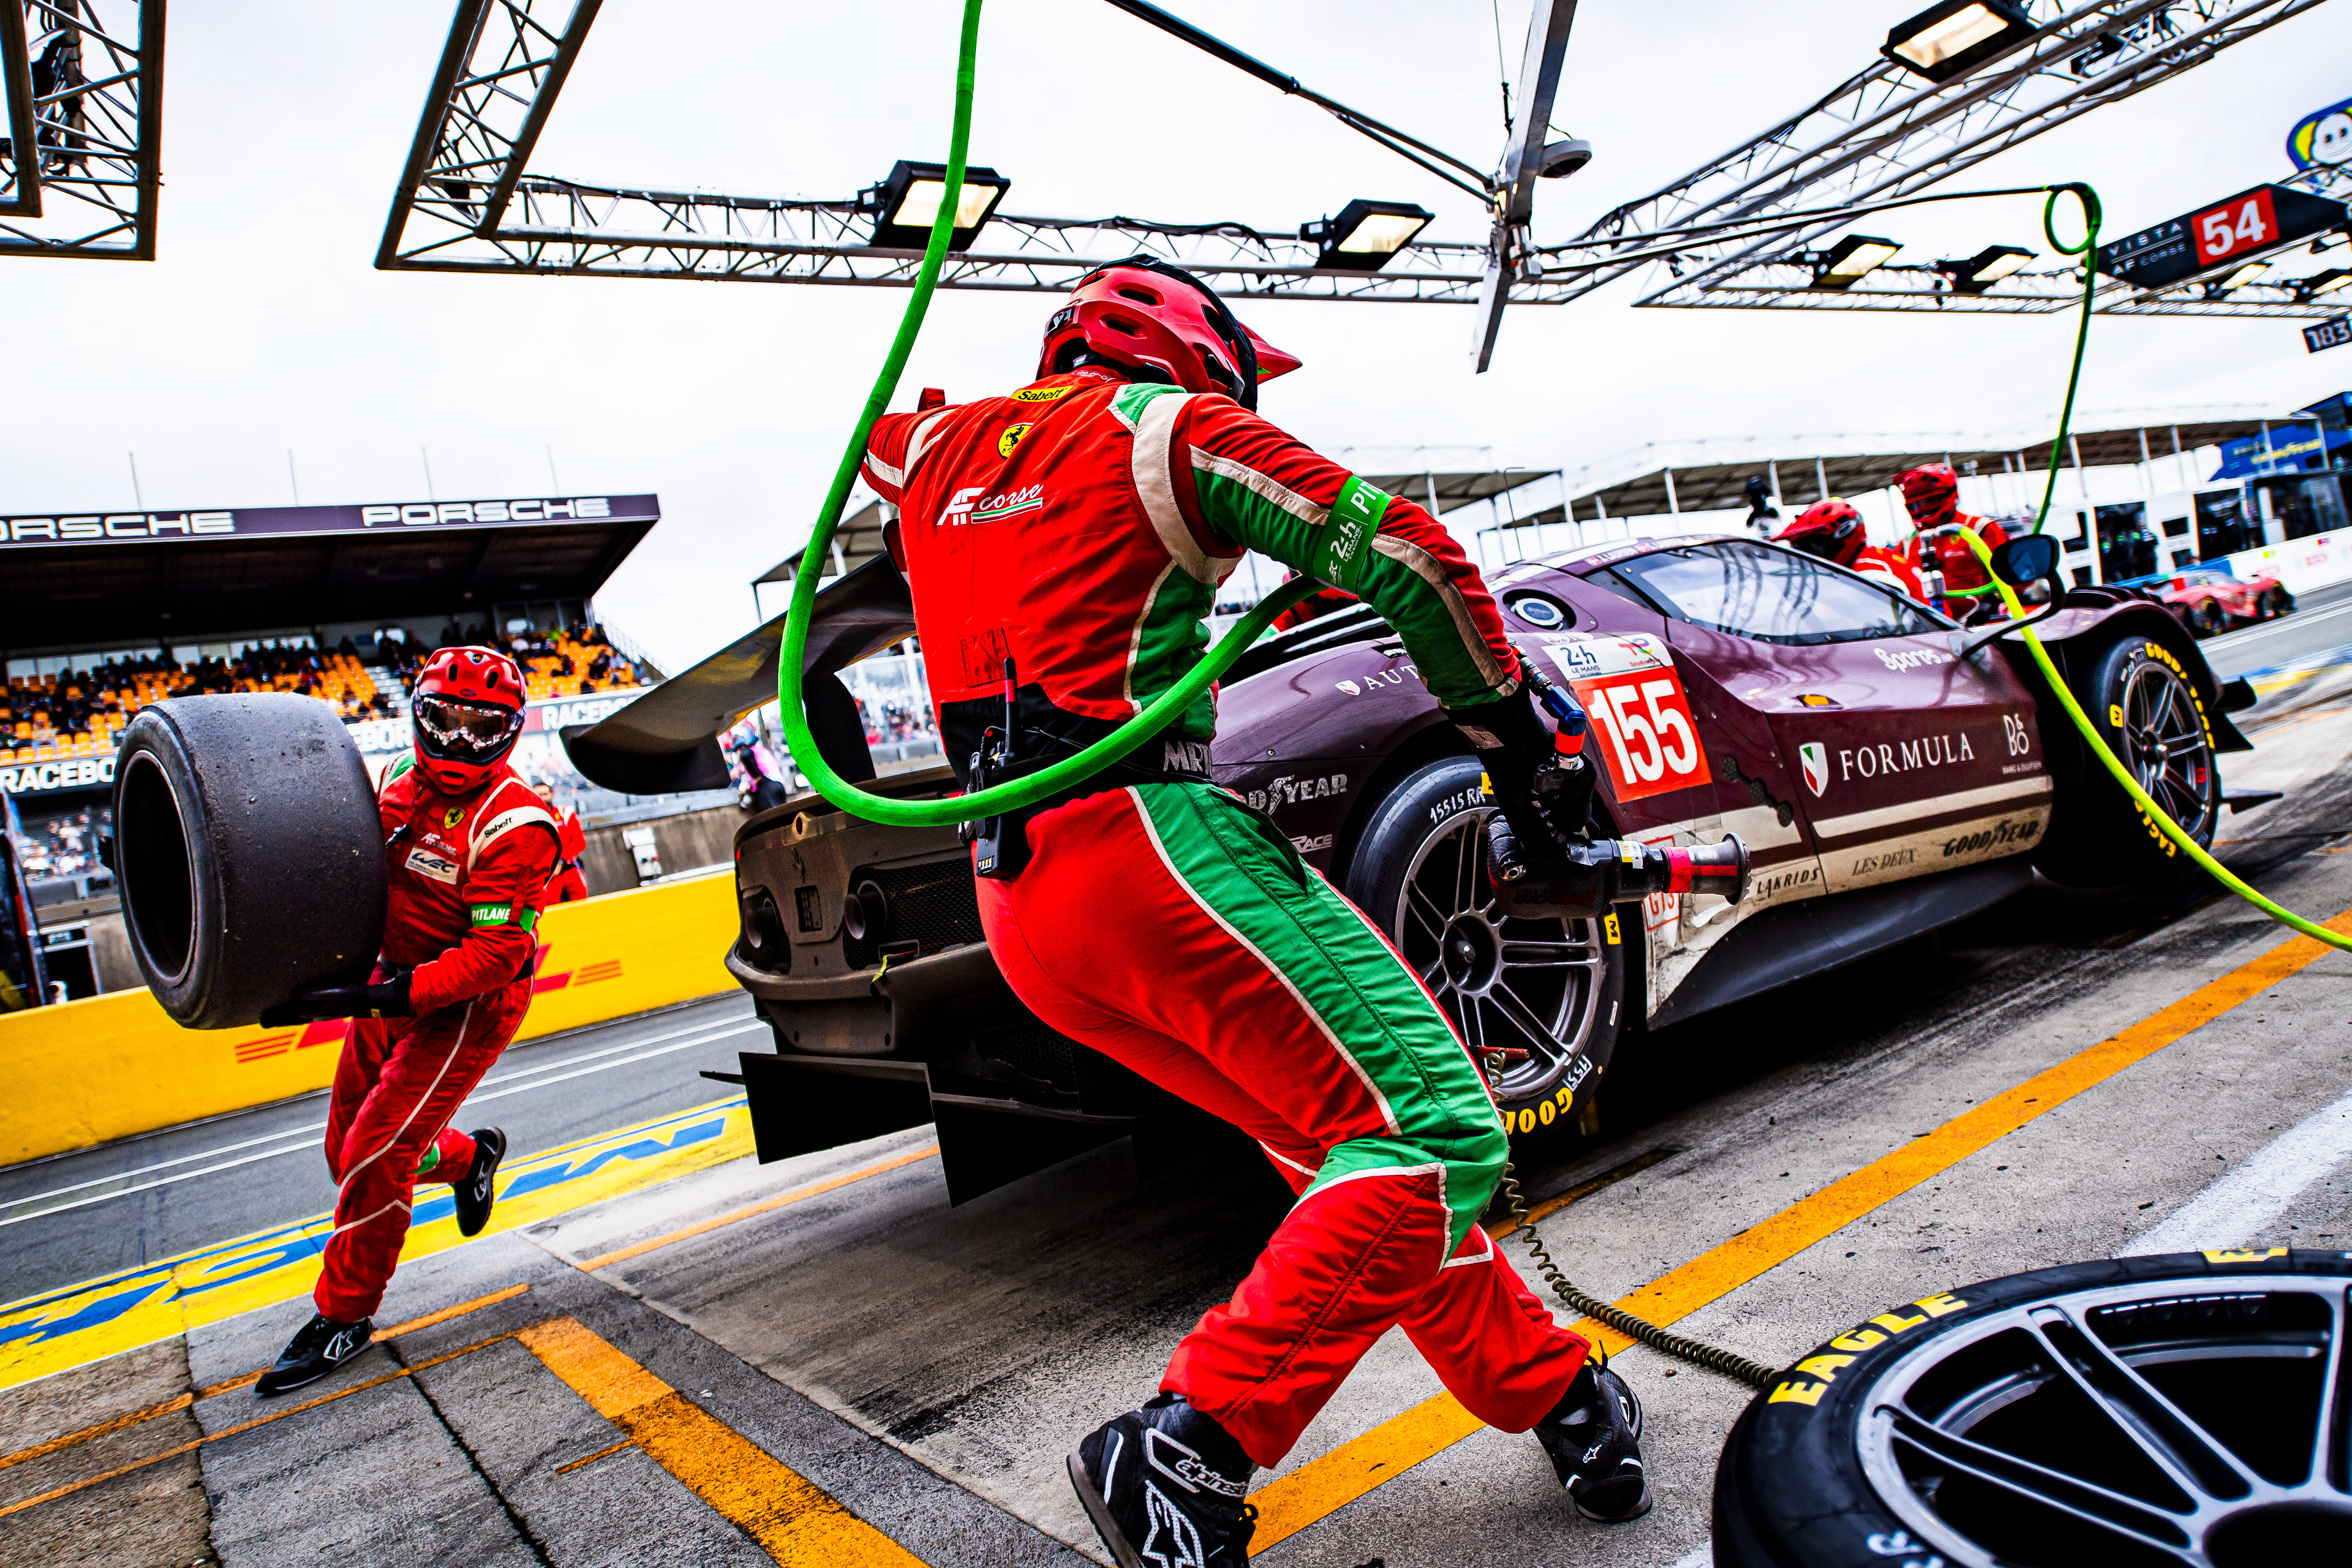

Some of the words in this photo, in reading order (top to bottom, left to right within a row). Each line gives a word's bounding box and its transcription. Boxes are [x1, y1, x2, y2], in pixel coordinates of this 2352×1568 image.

[2108, 222, 2182, 256] VISTA
[2203, 199, 2266, 257] 54
[2113, 258, 2135, 276] AF
[2139, 243, 2187, 266] CORSE
[2305, 321, 2350, 349] 183
[1017, 386, 1066, 401] Sabelt
[361, 497, 611, 527] PORSCHE
[979, 484, 1044, 510] corse
[1559, 644, 1597, 666] 24h
[1588, 679, 1697, 785] 155
[1839, 732, 1975, 781] FORMULA
[1466, 786, 1486, 807] RR
[1757, 867, 1820, 899] LAKRIDS
[472, 908, 511, 922] PITLANE
[1768, 1292, 1969, 1406] EAGLE
